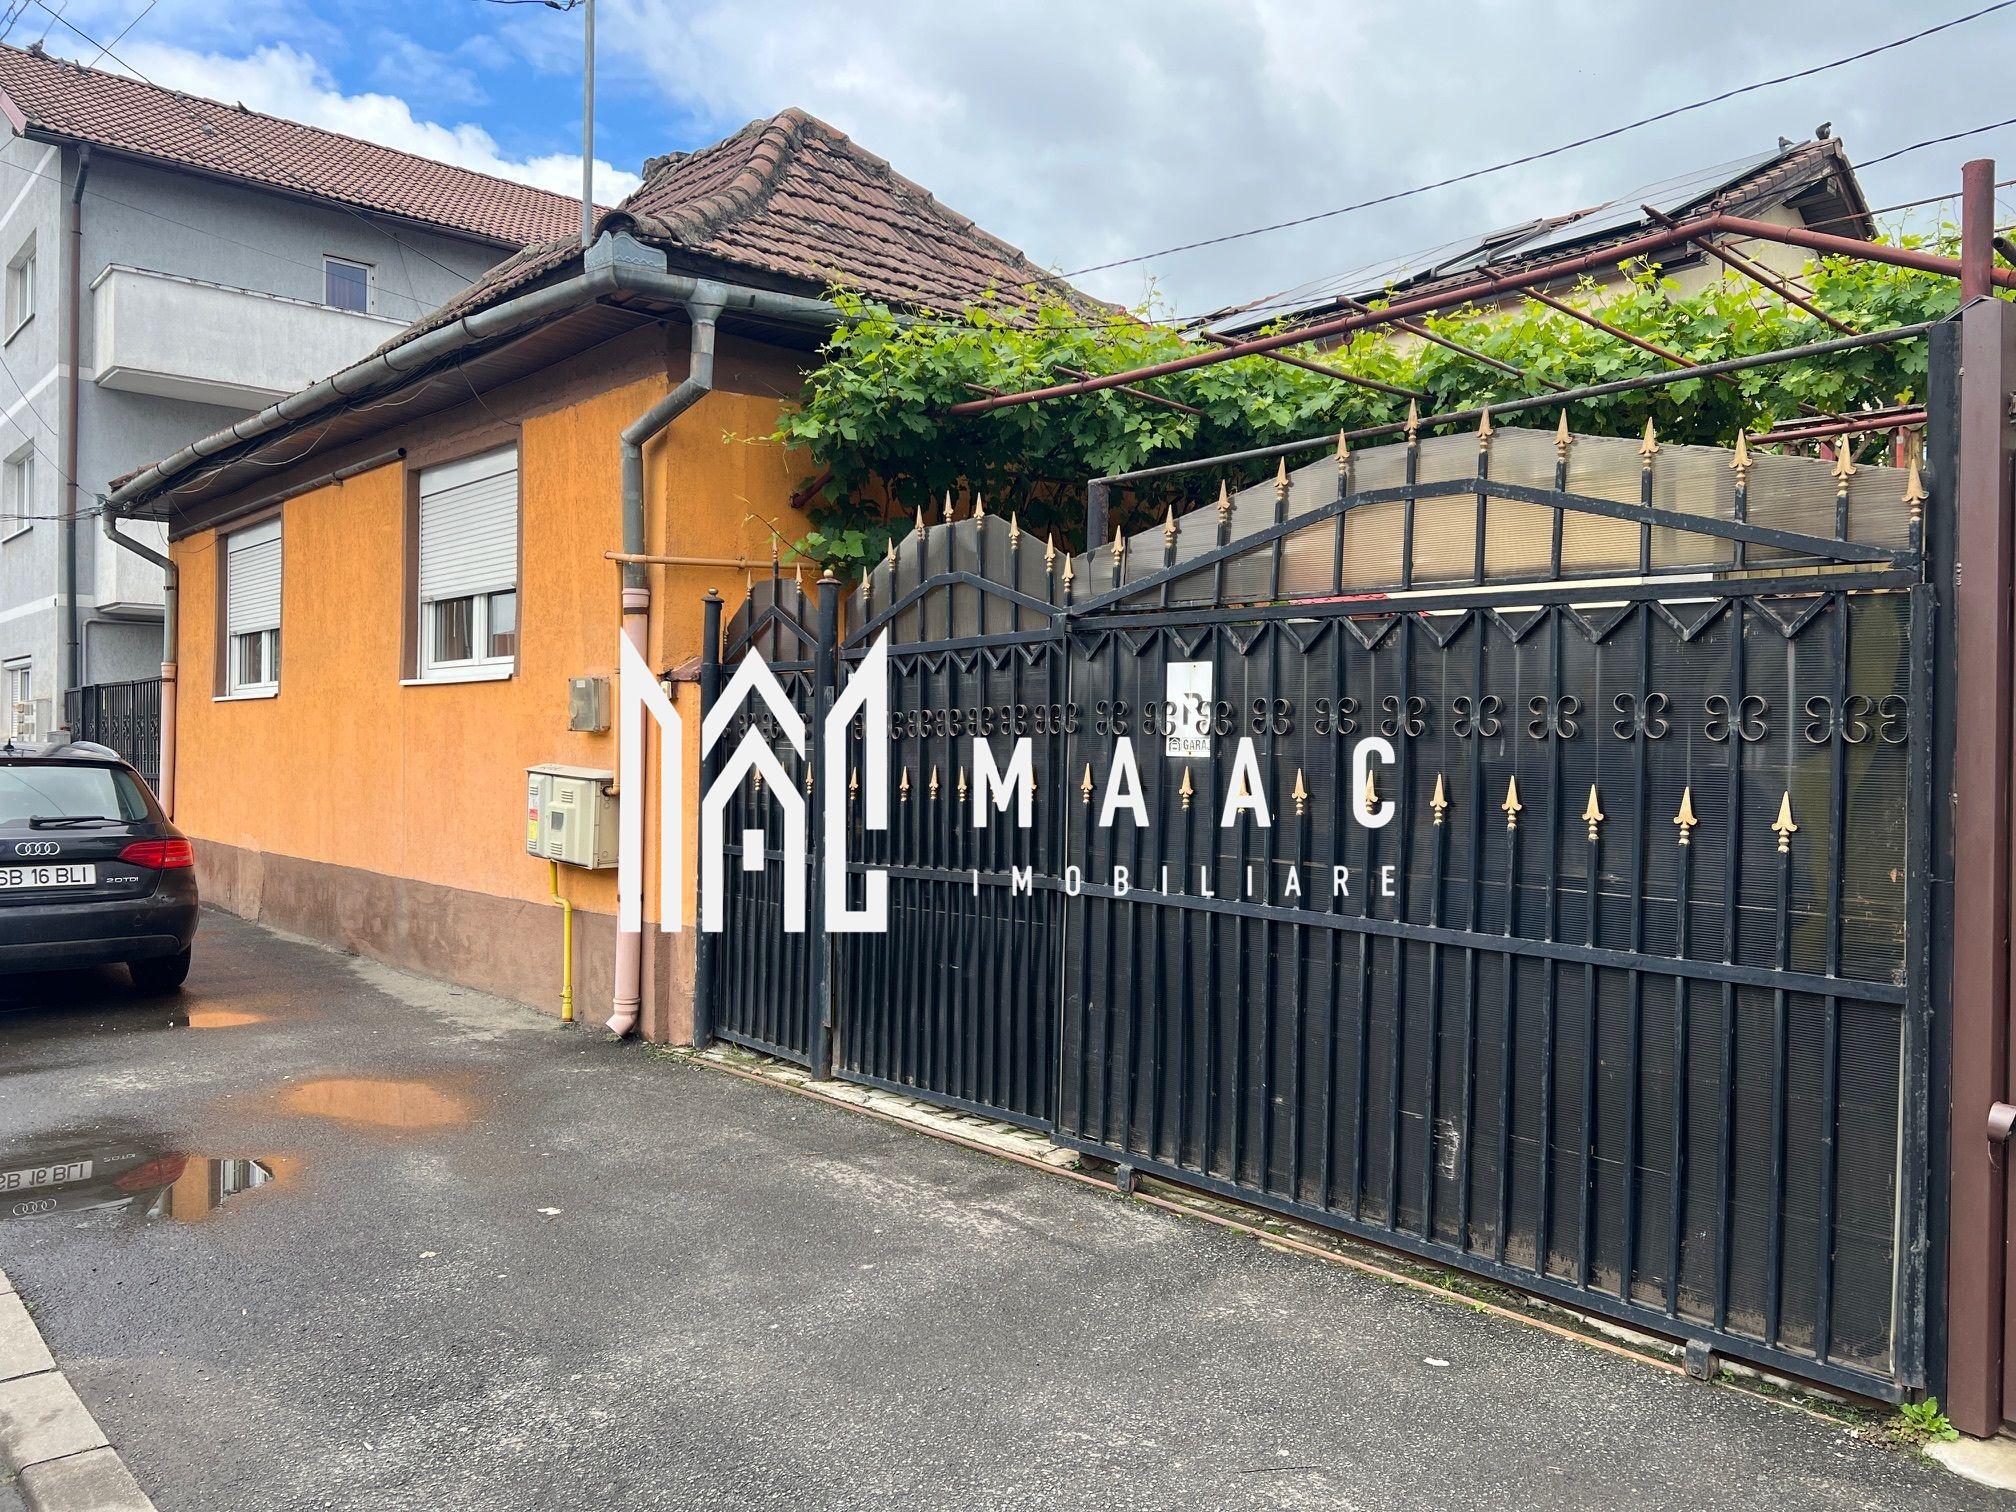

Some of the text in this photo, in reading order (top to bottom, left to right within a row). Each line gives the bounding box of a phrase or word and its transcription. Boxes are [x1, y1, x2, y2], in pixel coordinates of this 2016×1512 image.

[0, 866, 87, 886] SB 16 BLI
